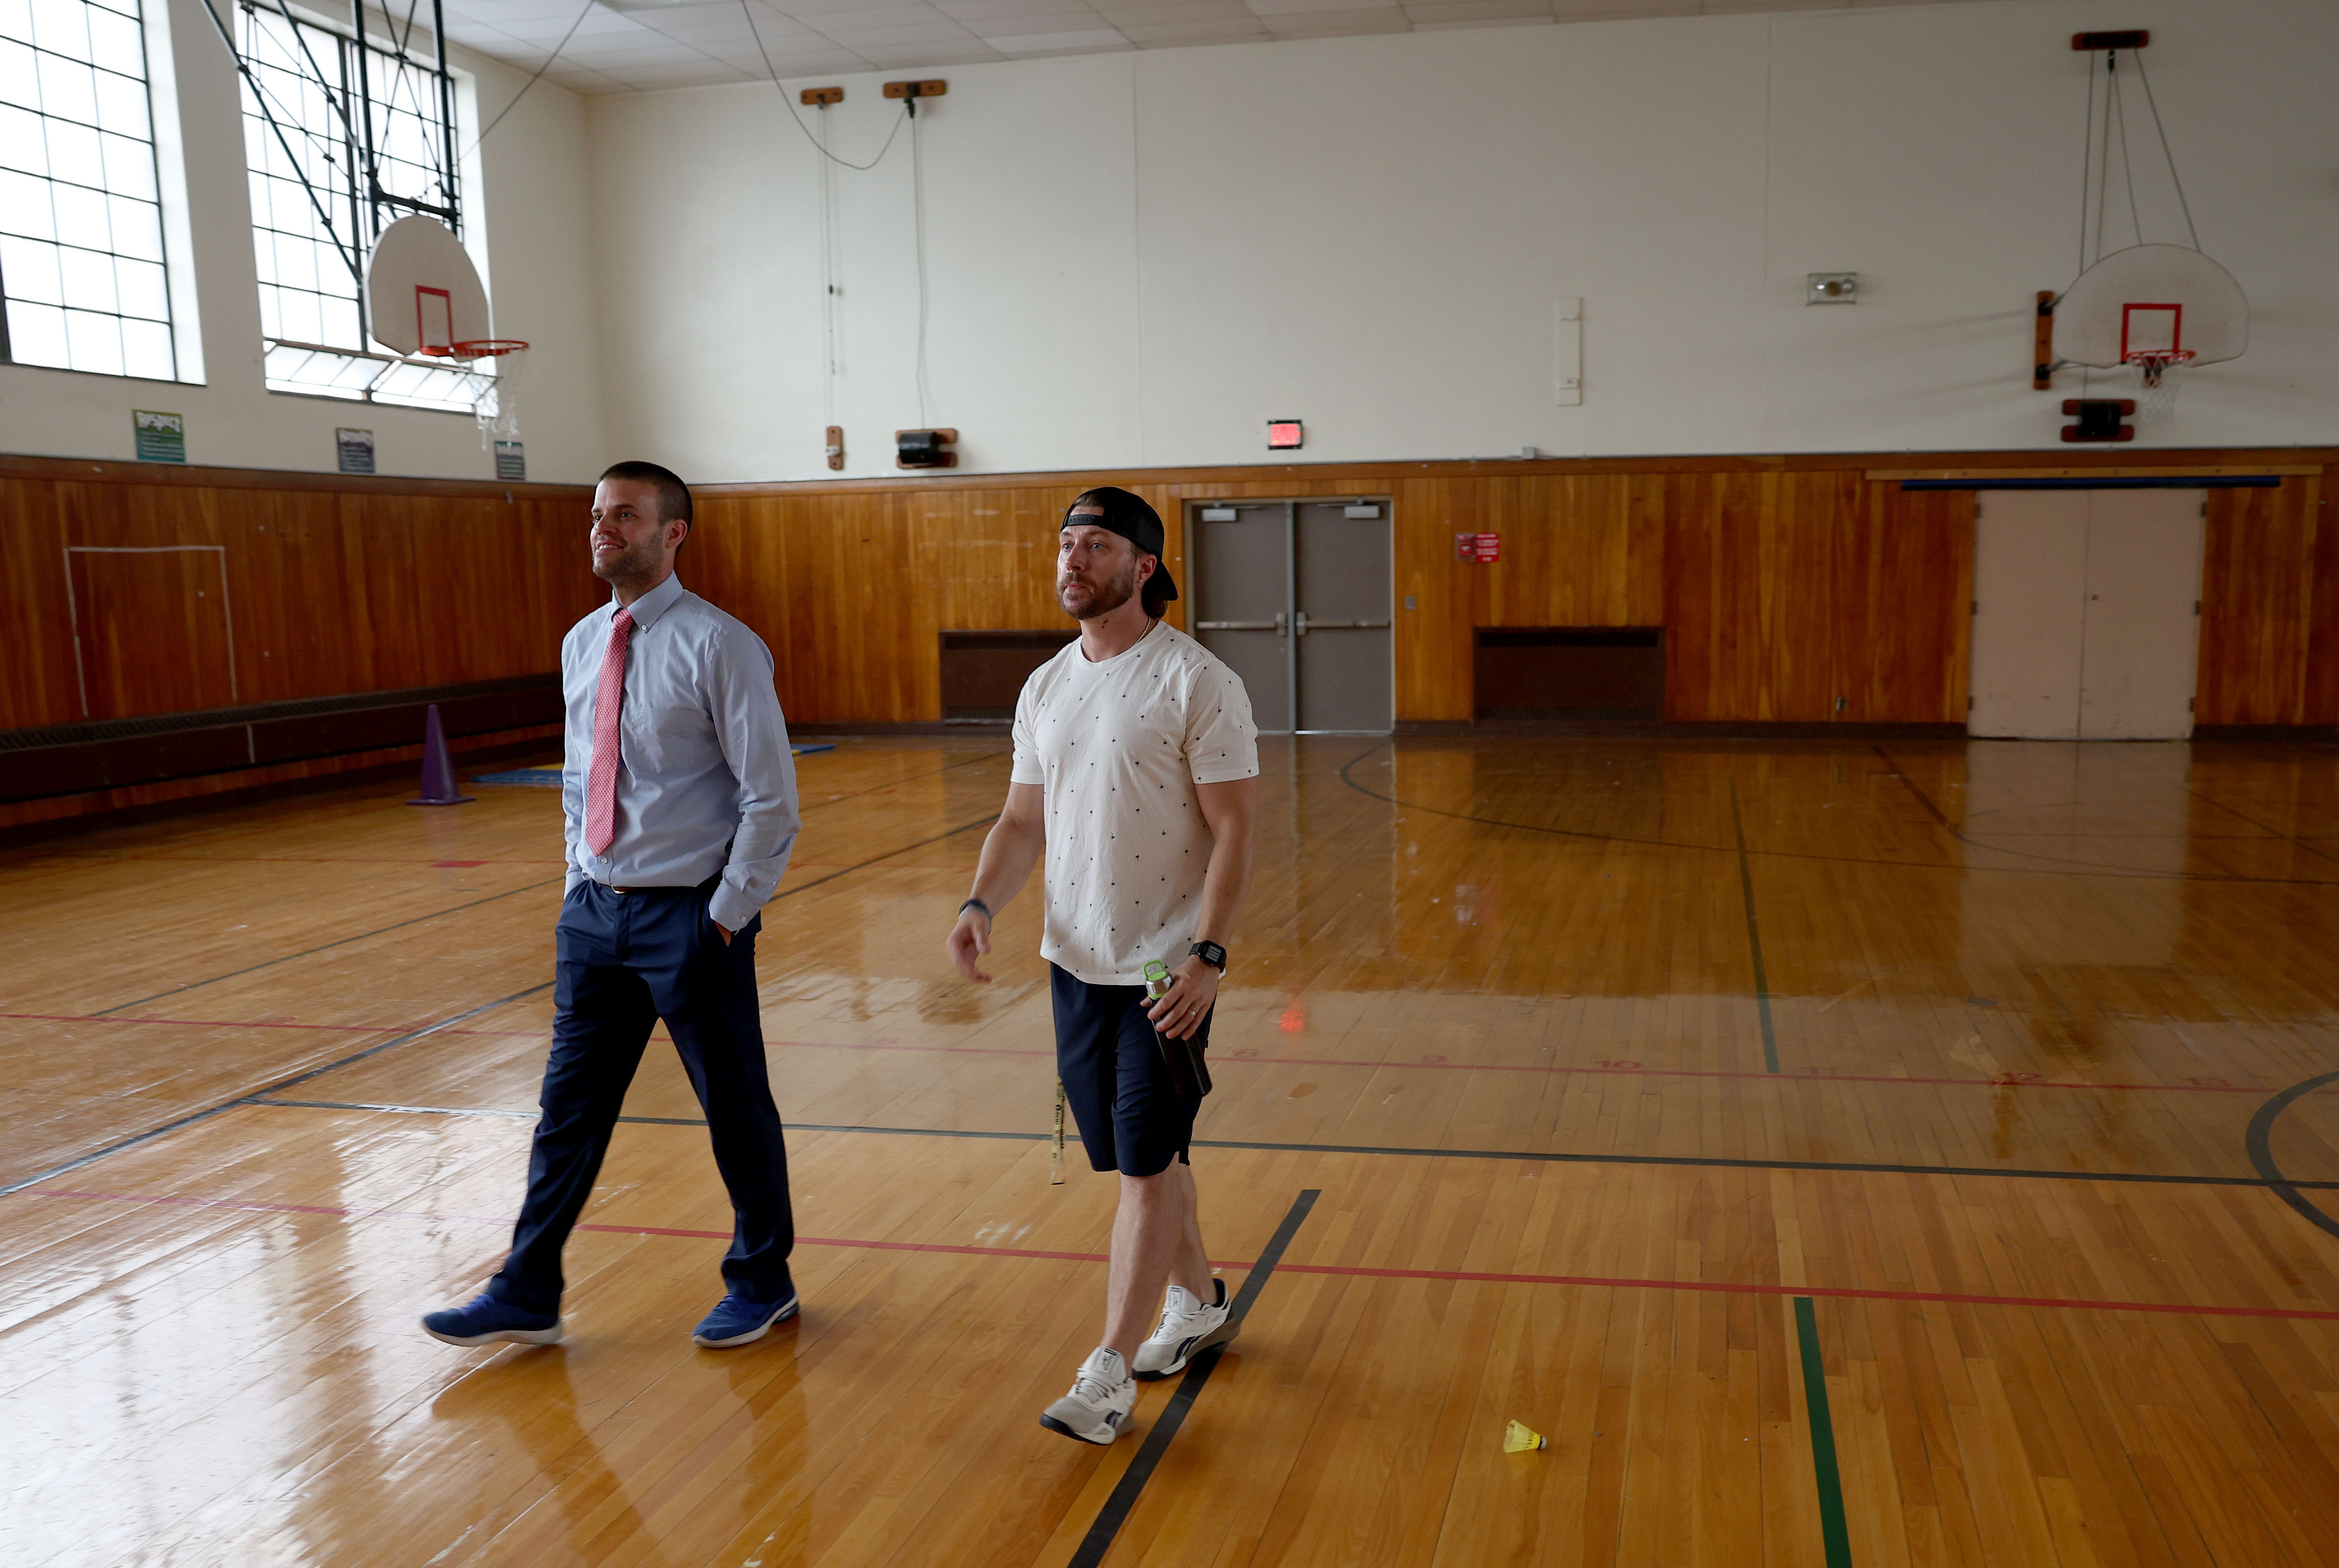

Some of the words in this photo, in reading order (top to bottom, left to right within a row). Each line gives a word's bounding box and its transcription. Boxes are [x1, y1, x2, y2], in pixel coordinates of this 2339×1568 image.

[1234, 1049, 1259, 1057] 8
[1594, 1060, 1641, 1069] 10
[1999, 1072, 2046, 1082] 12
